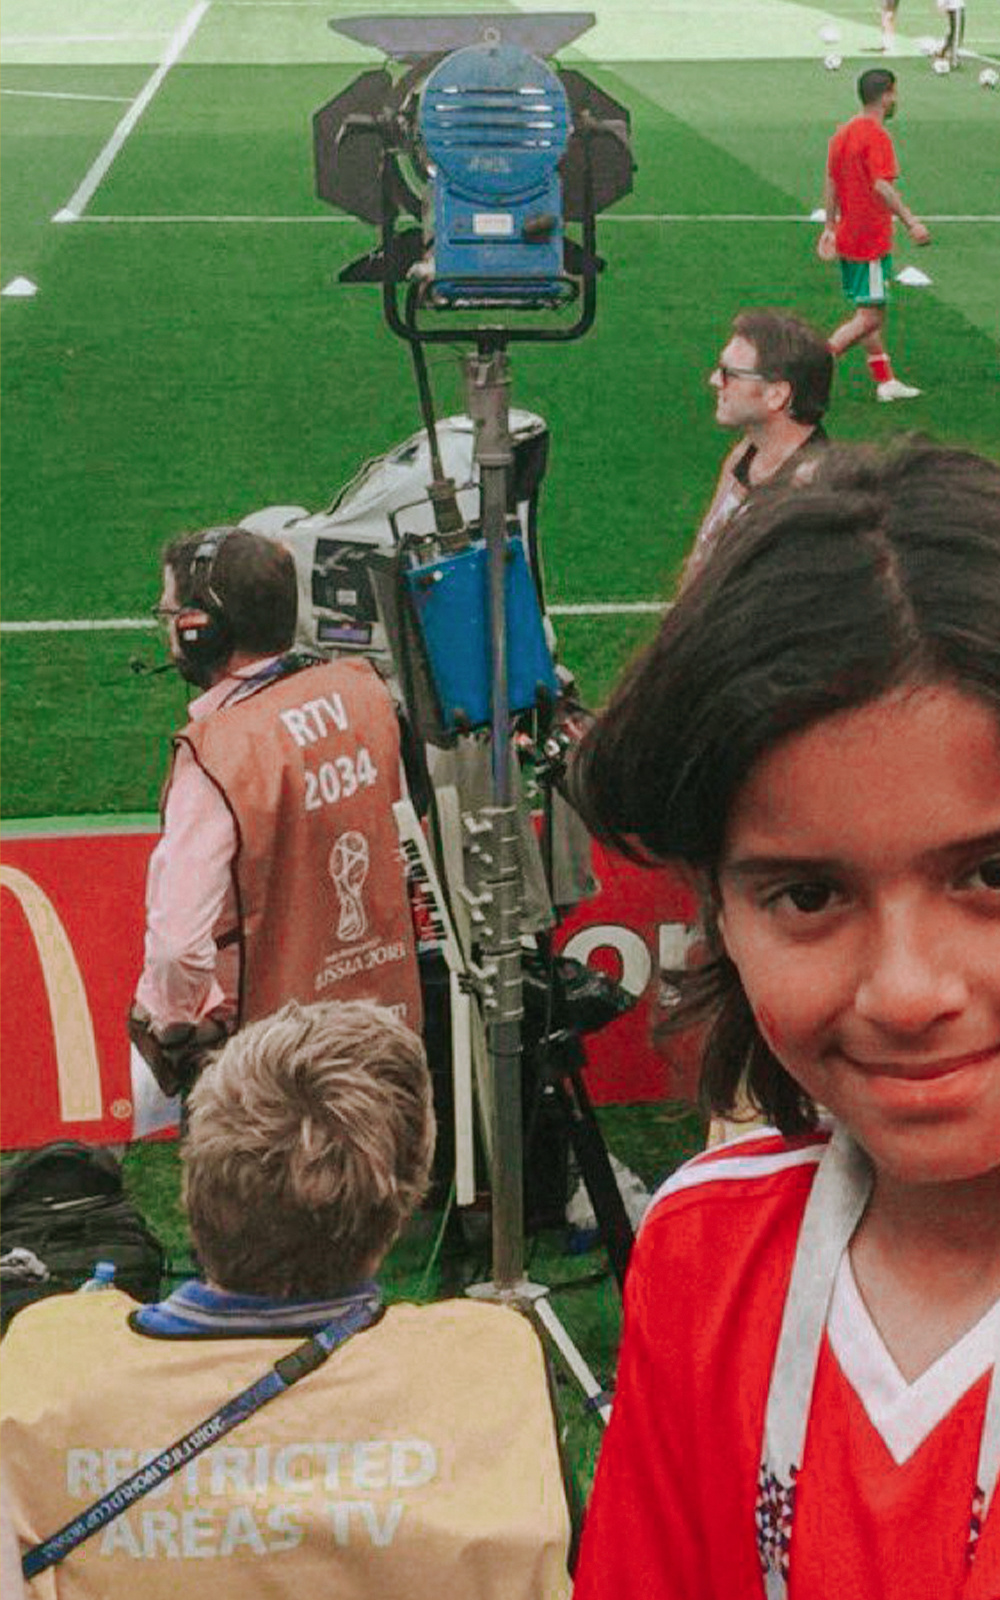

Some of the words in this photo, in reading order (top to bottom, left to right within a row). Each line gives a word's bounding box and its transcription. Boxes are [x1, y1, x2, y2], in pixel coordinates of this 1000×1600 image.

[280, 693, 348, 746] RTV
[304, 748, 378, 810] 2034
[99, 1503, 303, 1558] AREAS
[326, 1500, 405, 1547] TV
